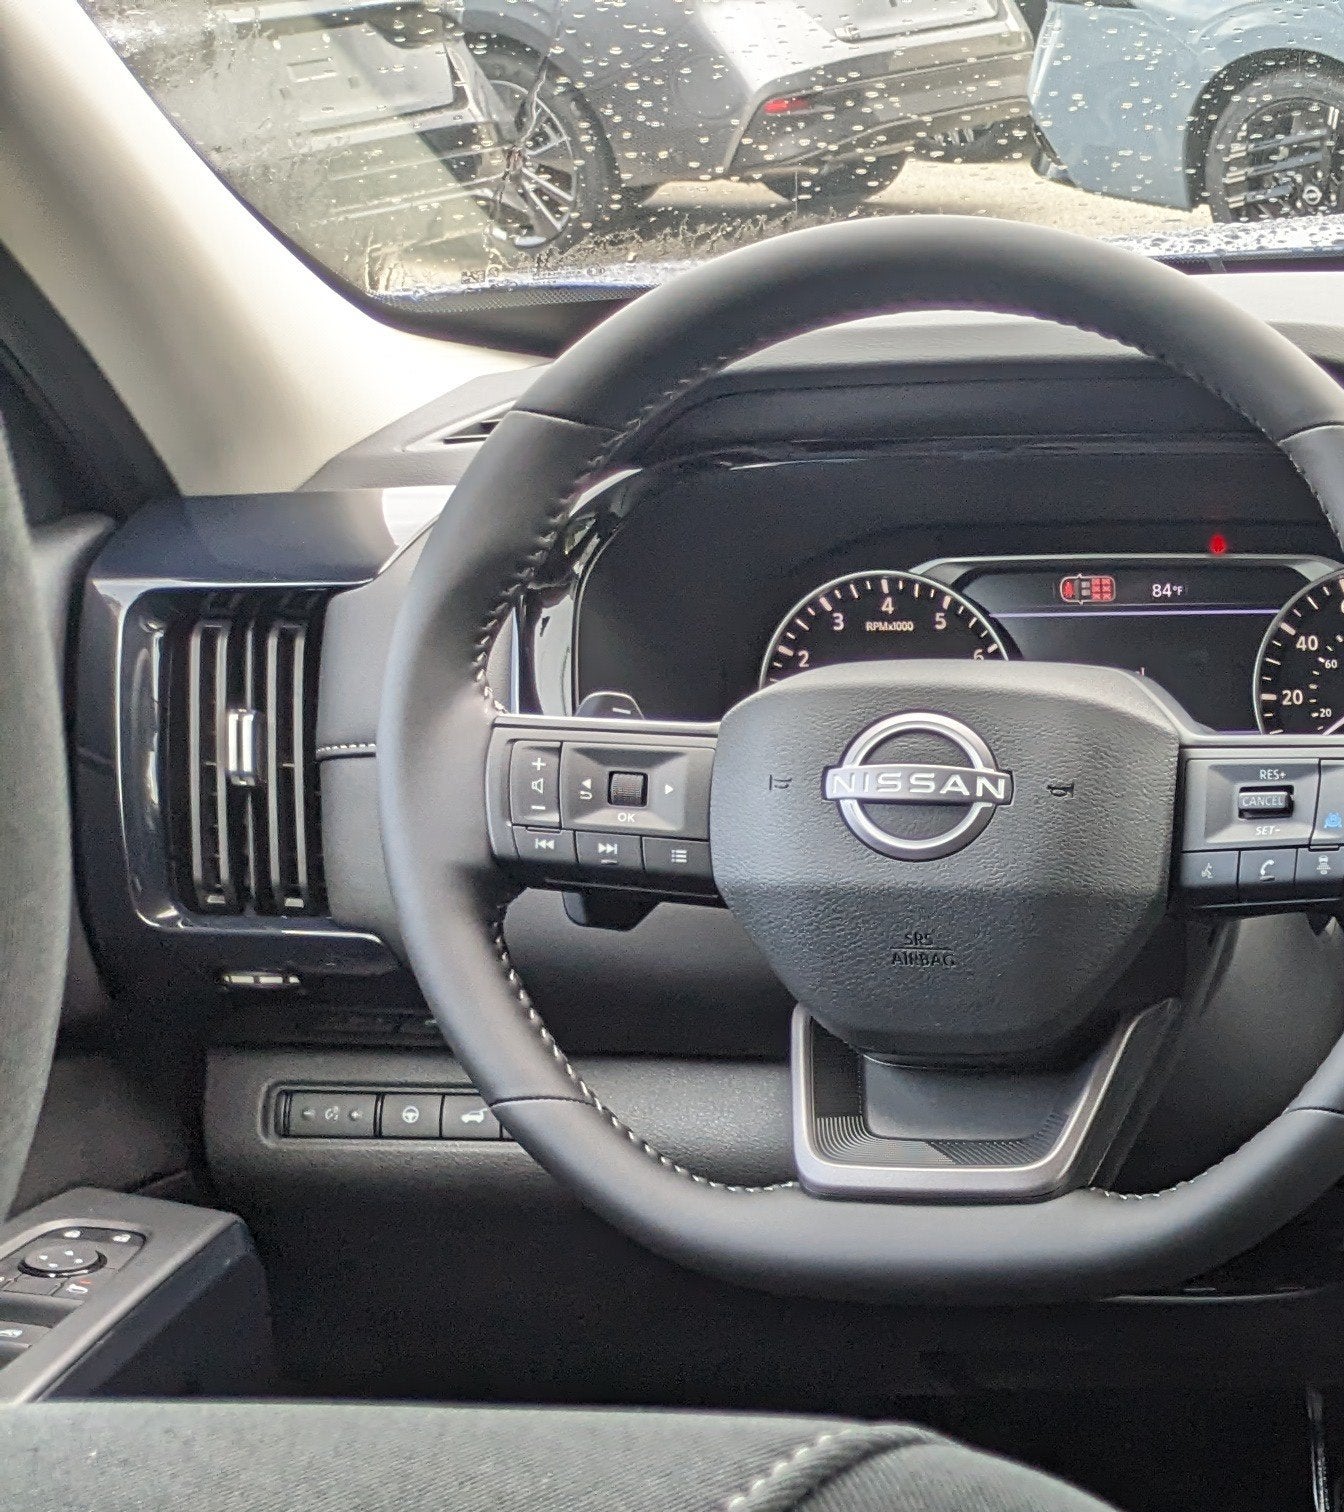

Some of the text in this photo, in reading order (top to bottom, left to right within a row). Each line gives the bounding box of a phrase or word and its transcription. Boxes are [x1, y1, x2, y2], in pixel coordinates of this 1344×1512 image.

[880, 597, 895, 615] 4
[832, 612, 845, 631] 3
[935, 612, 947, 630] 5
[1295, 635, 1318, 651] 40
[798, 650, 810, 668] 2
[1325, 659, 1338, 669] 60
[1282, 689, 1303, 705] 20
[1319, 708, 1332, 718] 20
[1259, 769, 1287, 780] RES+
[832, 772, 1006, 799] NISSAN
[1242, 795, 1284, 807] CANCEL
[617, 813, 635, 823] OK
